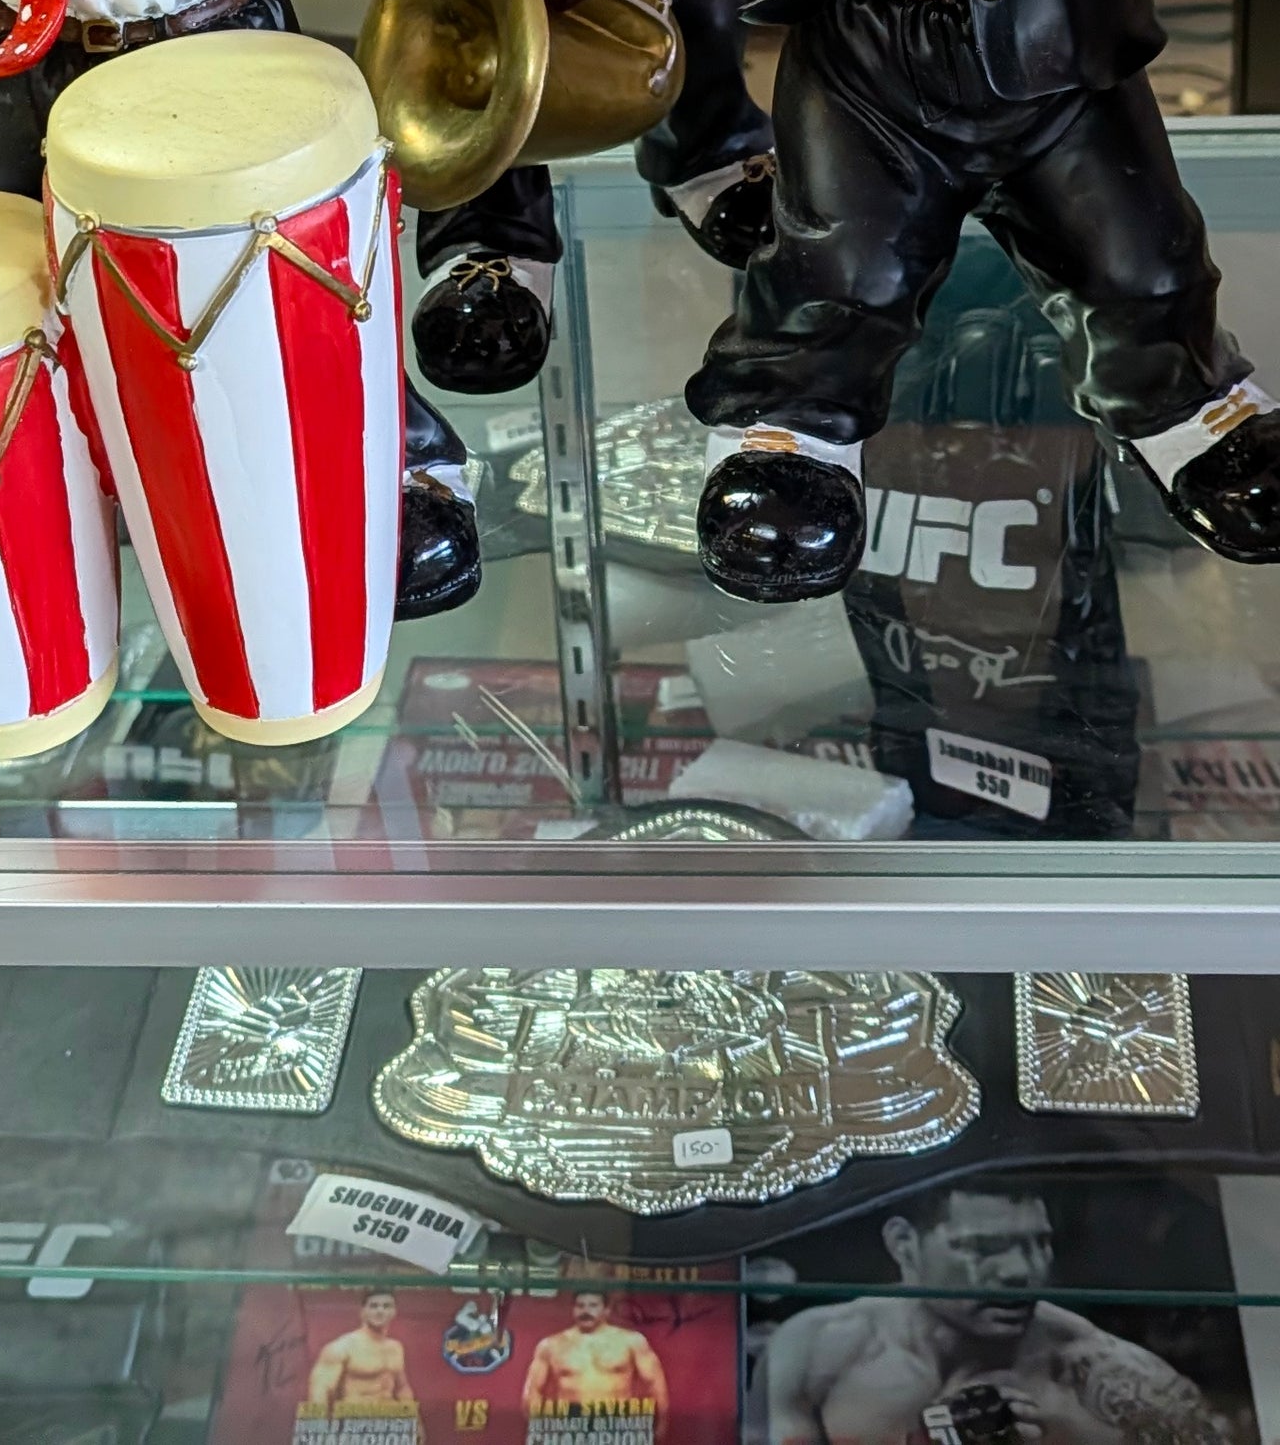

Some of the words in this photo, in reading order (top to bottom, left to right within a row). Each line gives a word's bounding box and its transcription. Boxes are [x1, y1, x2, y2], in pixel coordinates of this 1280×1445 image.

[857, 486, 1038, 590] UFC
[976, 770, 1010, 799] $50
[523, 1081, 818, 1120] CHAMPION
[329, 1186, 419, 1221] SHOGUN
[417, 1208, 465, 1239] RUA
[353, 1214, 411, 1244] $150
[455, 1399, 489, 1431] VS
